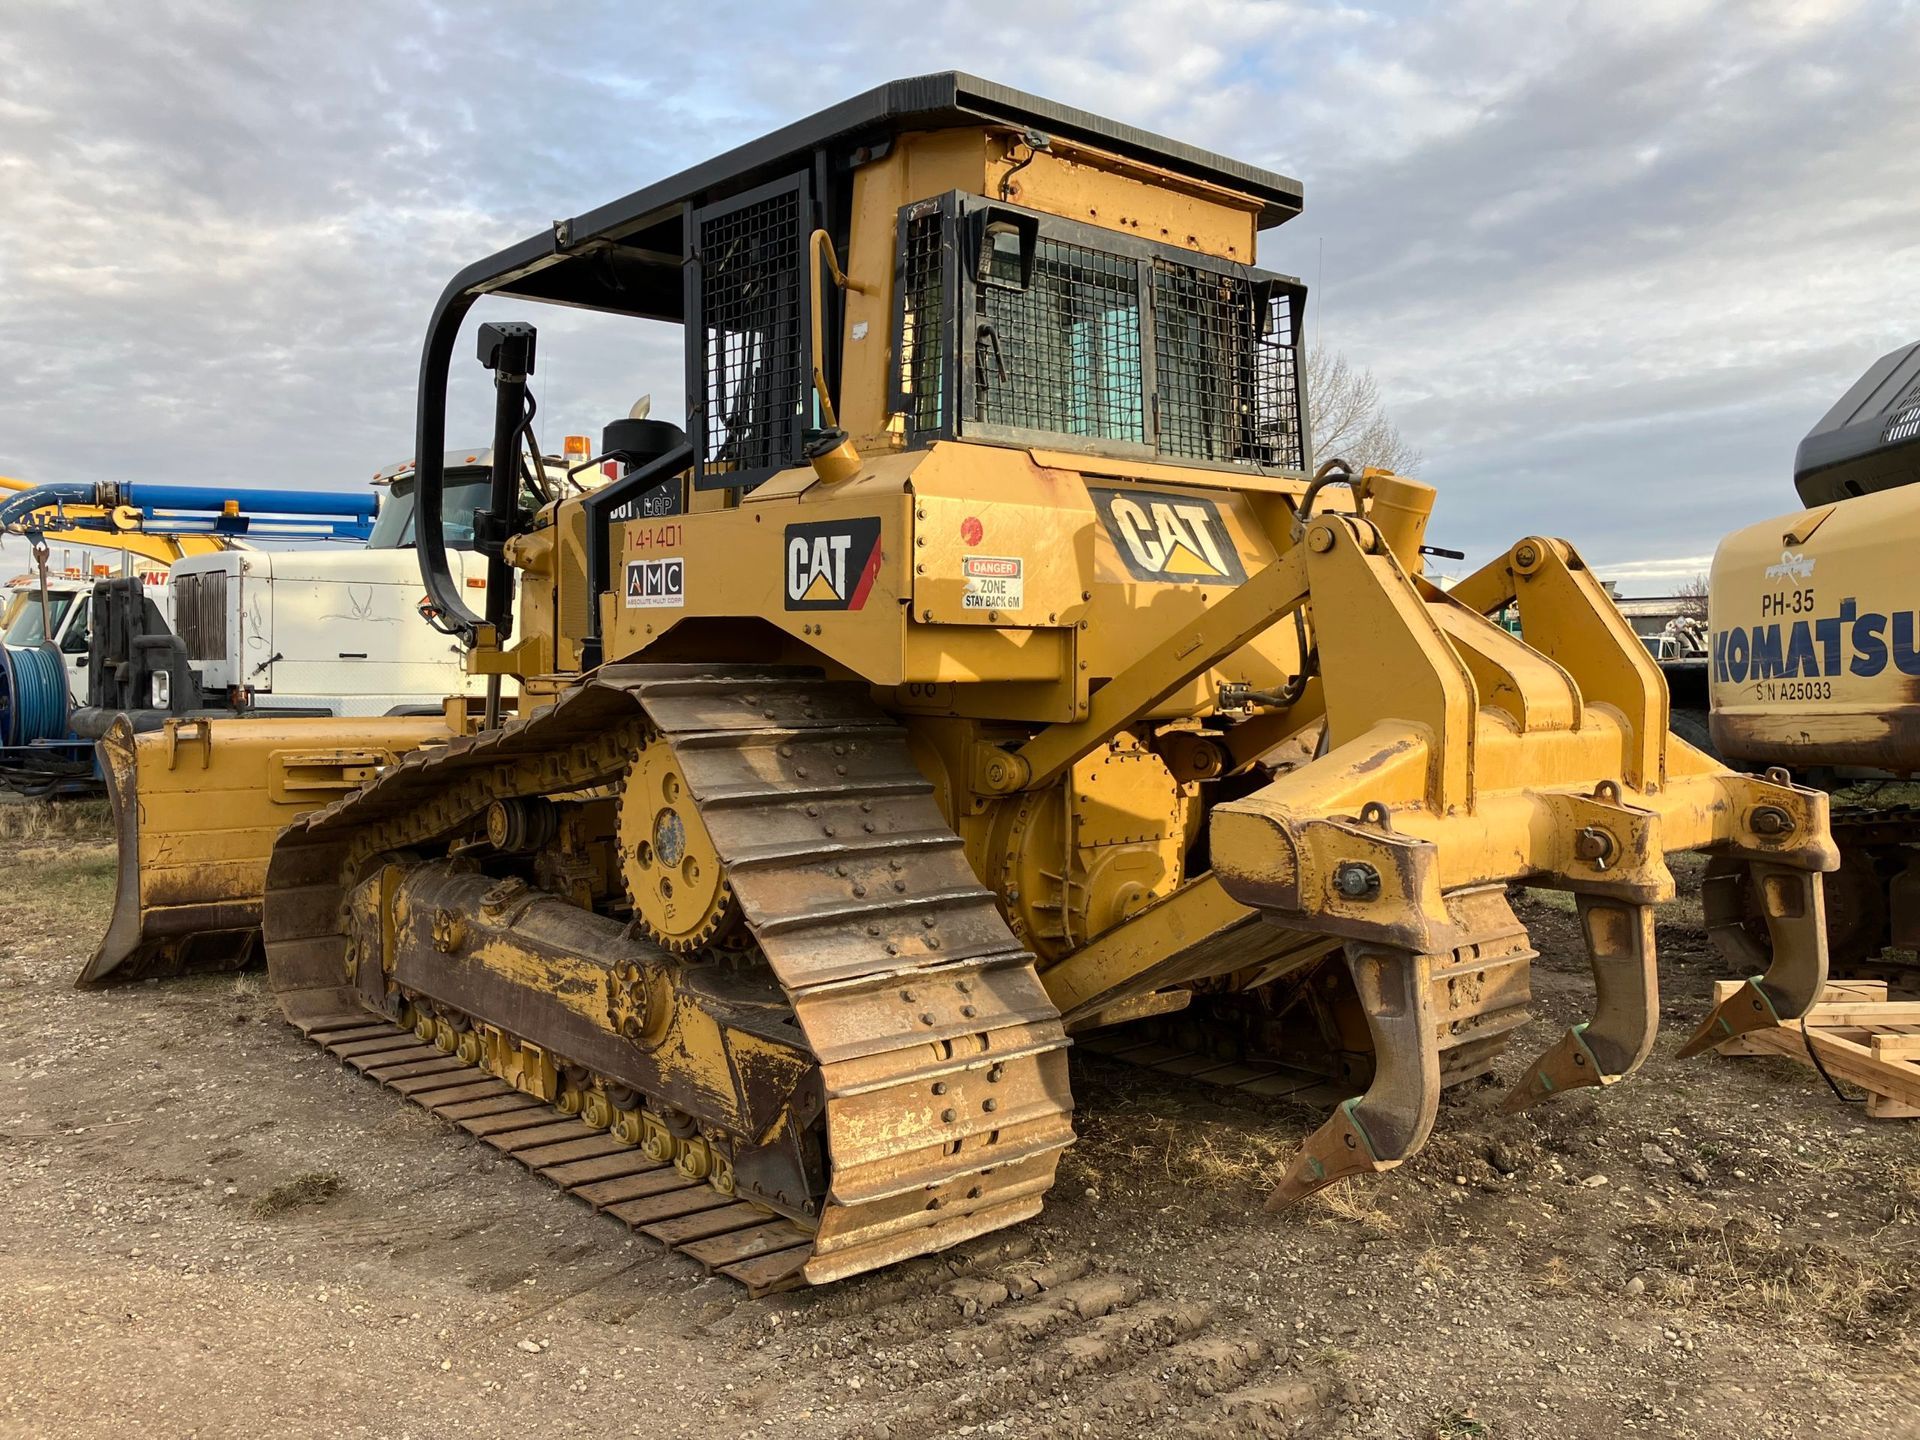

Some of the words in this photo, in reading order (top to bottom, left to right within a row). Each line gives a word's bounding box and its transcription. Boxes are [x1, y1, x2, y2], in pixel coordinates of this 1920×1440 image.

[643, 497, 673, 517] LGP
[628, 524, 683, 551] 14-1401
[1110, 498, 1230, 576] CAT
[629, 565, 680, 594] AMC
[788, 535, 851, 601] CAT
[973, 562, 1013, 574] DANGER
[980, 580, 1007, 594] ZONE
[966, 595, 984, 607] STAY
[985, 595, 1006, 607] BACK
[1008, 597, 1020, 608] 6M
[1762, 589, 1815, 617] PH-35
[1713, 597, 1920, 684] KOMATSU
[1780, 681, 1832, 701] A25033
